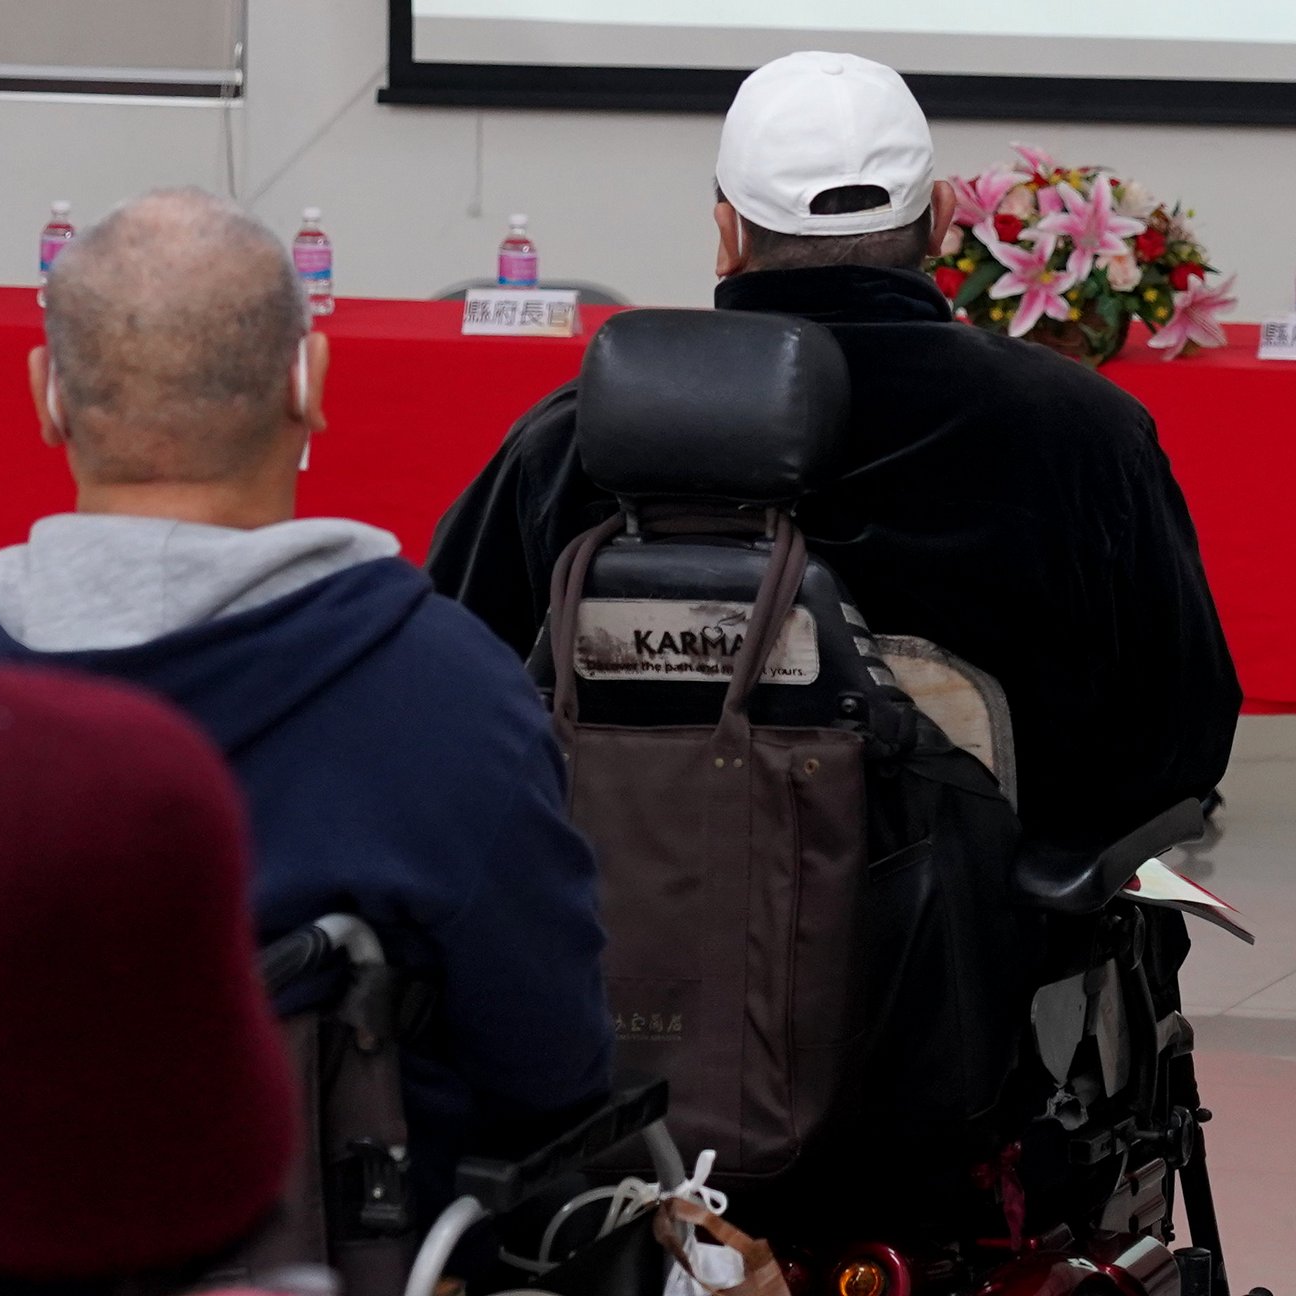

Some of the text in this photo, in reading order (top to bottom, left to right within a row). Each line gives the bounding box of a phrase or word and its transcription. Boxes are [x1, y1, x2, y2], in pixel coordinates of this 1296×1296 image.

[641, 661, 661, 672] the
[665, 662, 693, 675] path
[696, 664, 719, 673] and
[770, 666, 806, 678] yours.
